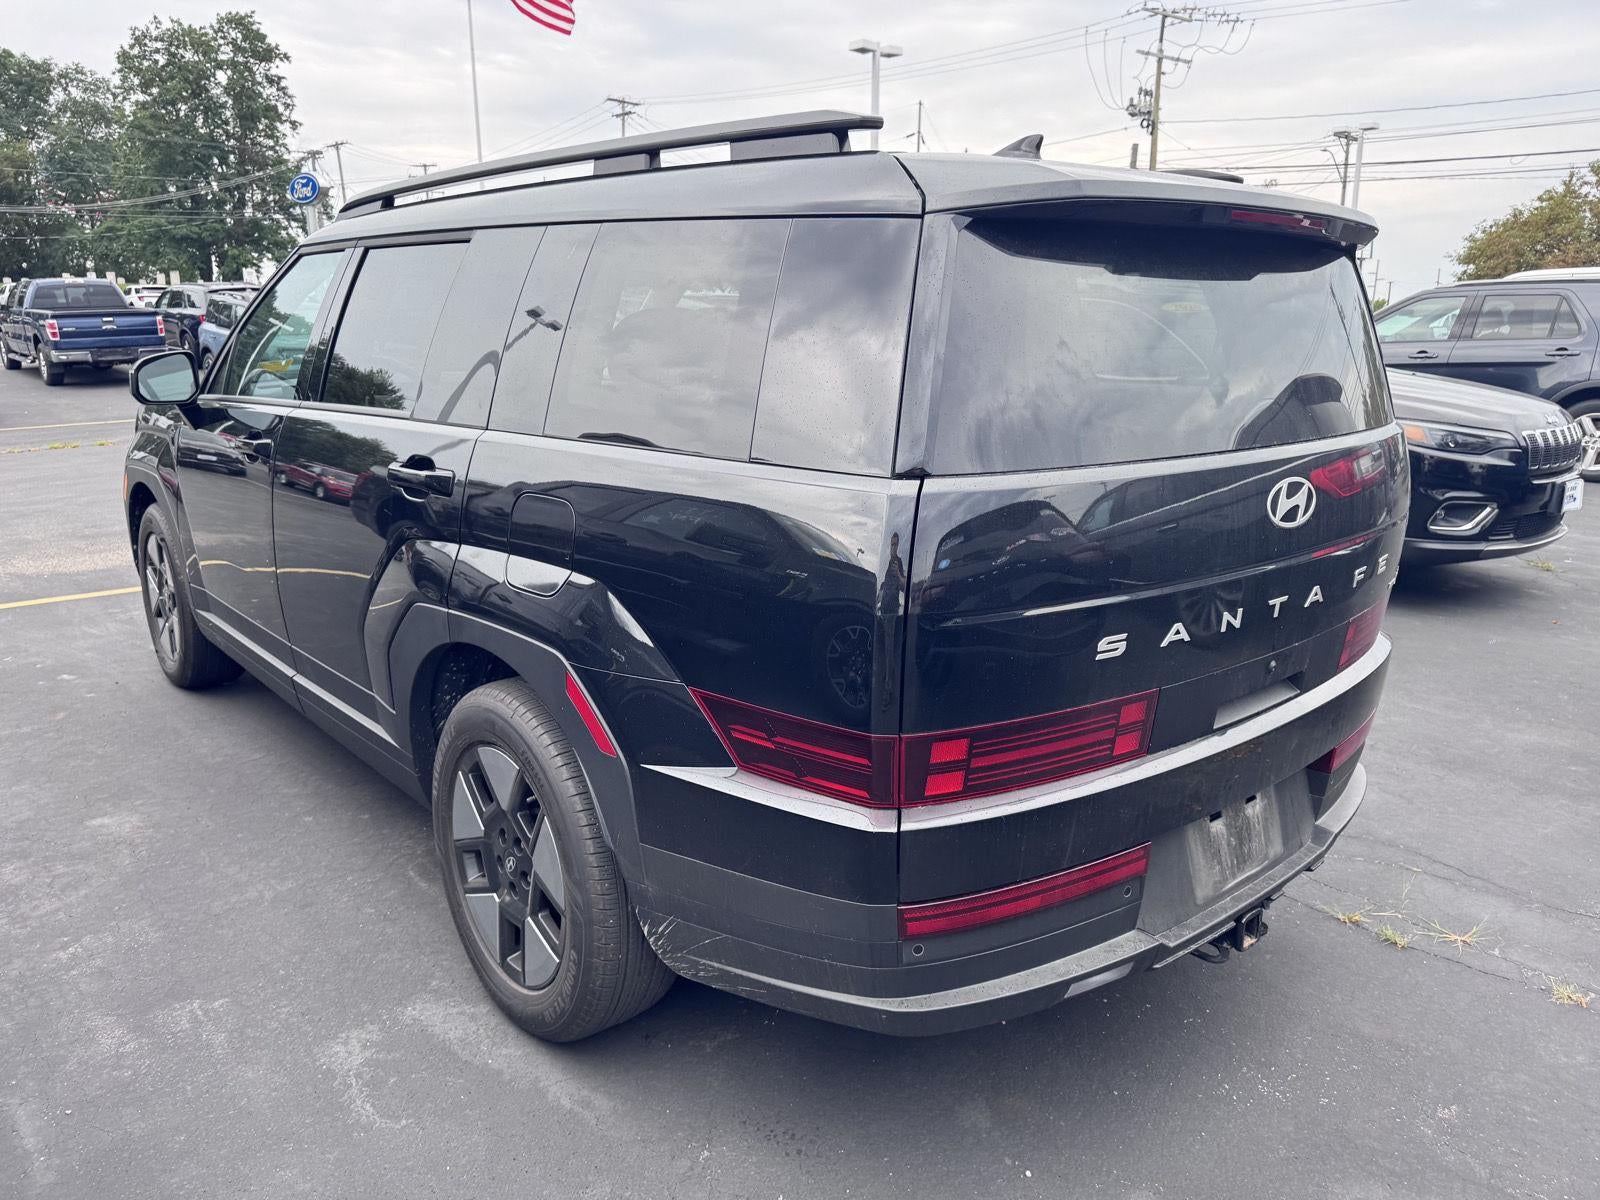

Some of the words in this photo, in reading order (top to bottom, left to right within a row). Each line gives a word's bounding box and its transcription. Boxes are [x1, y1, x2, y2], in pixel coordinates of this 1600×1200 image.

[293, 178, 313, 198] Ford
[1095, 585, 1325, 661] SANTA
[1352, 553, 1390, 589] FE
